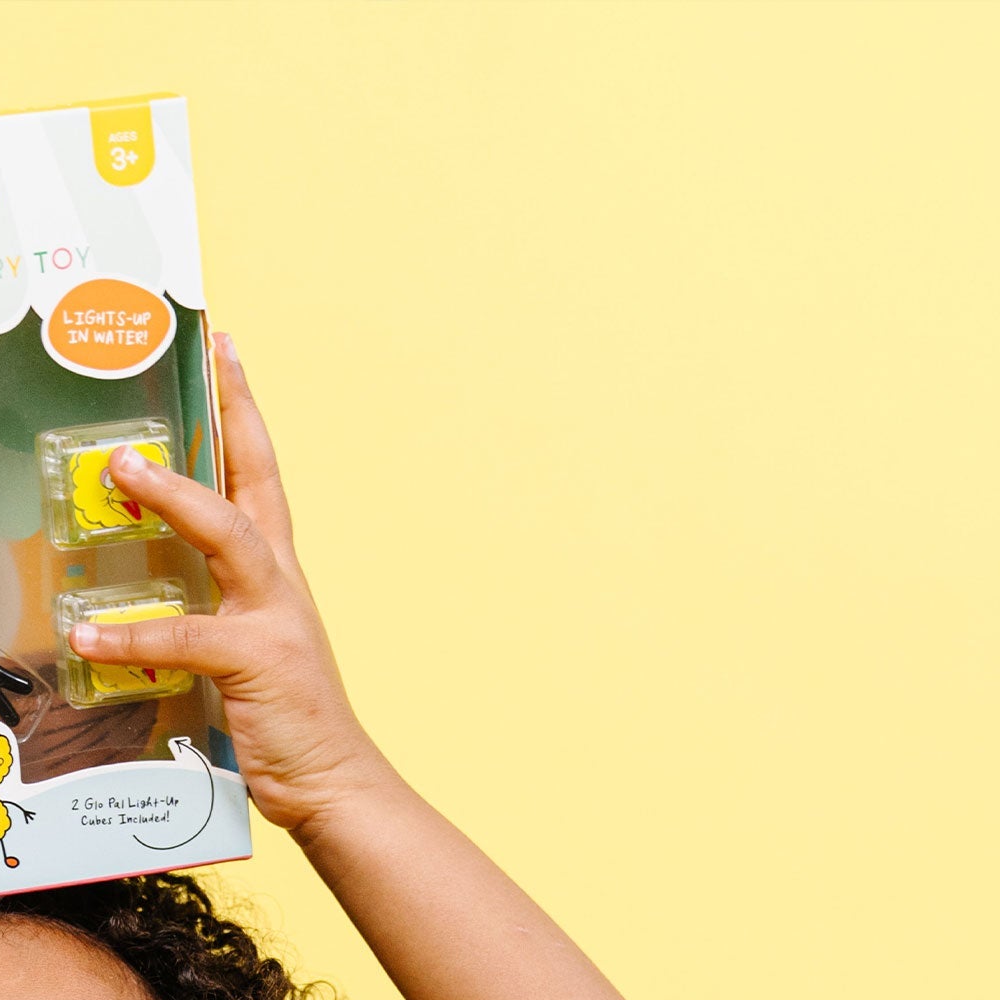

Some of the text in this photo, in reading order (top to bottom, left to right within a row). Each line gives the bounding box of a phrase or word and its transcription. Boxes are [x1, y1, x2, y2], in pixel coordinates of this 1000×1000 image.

[108, 130, 138, 143] AGES
[110, 146, 139, 171] 3+
[34, 246, 90, 274] TOY
[63, 309, 151, 327] LIGHTS-UP
[67, 329, 149, 345] IN WATER!
[71, 795, 179, 810] 2 Glo Pal Light-Up
[81, 810, 170, 826] Cubes Included!
